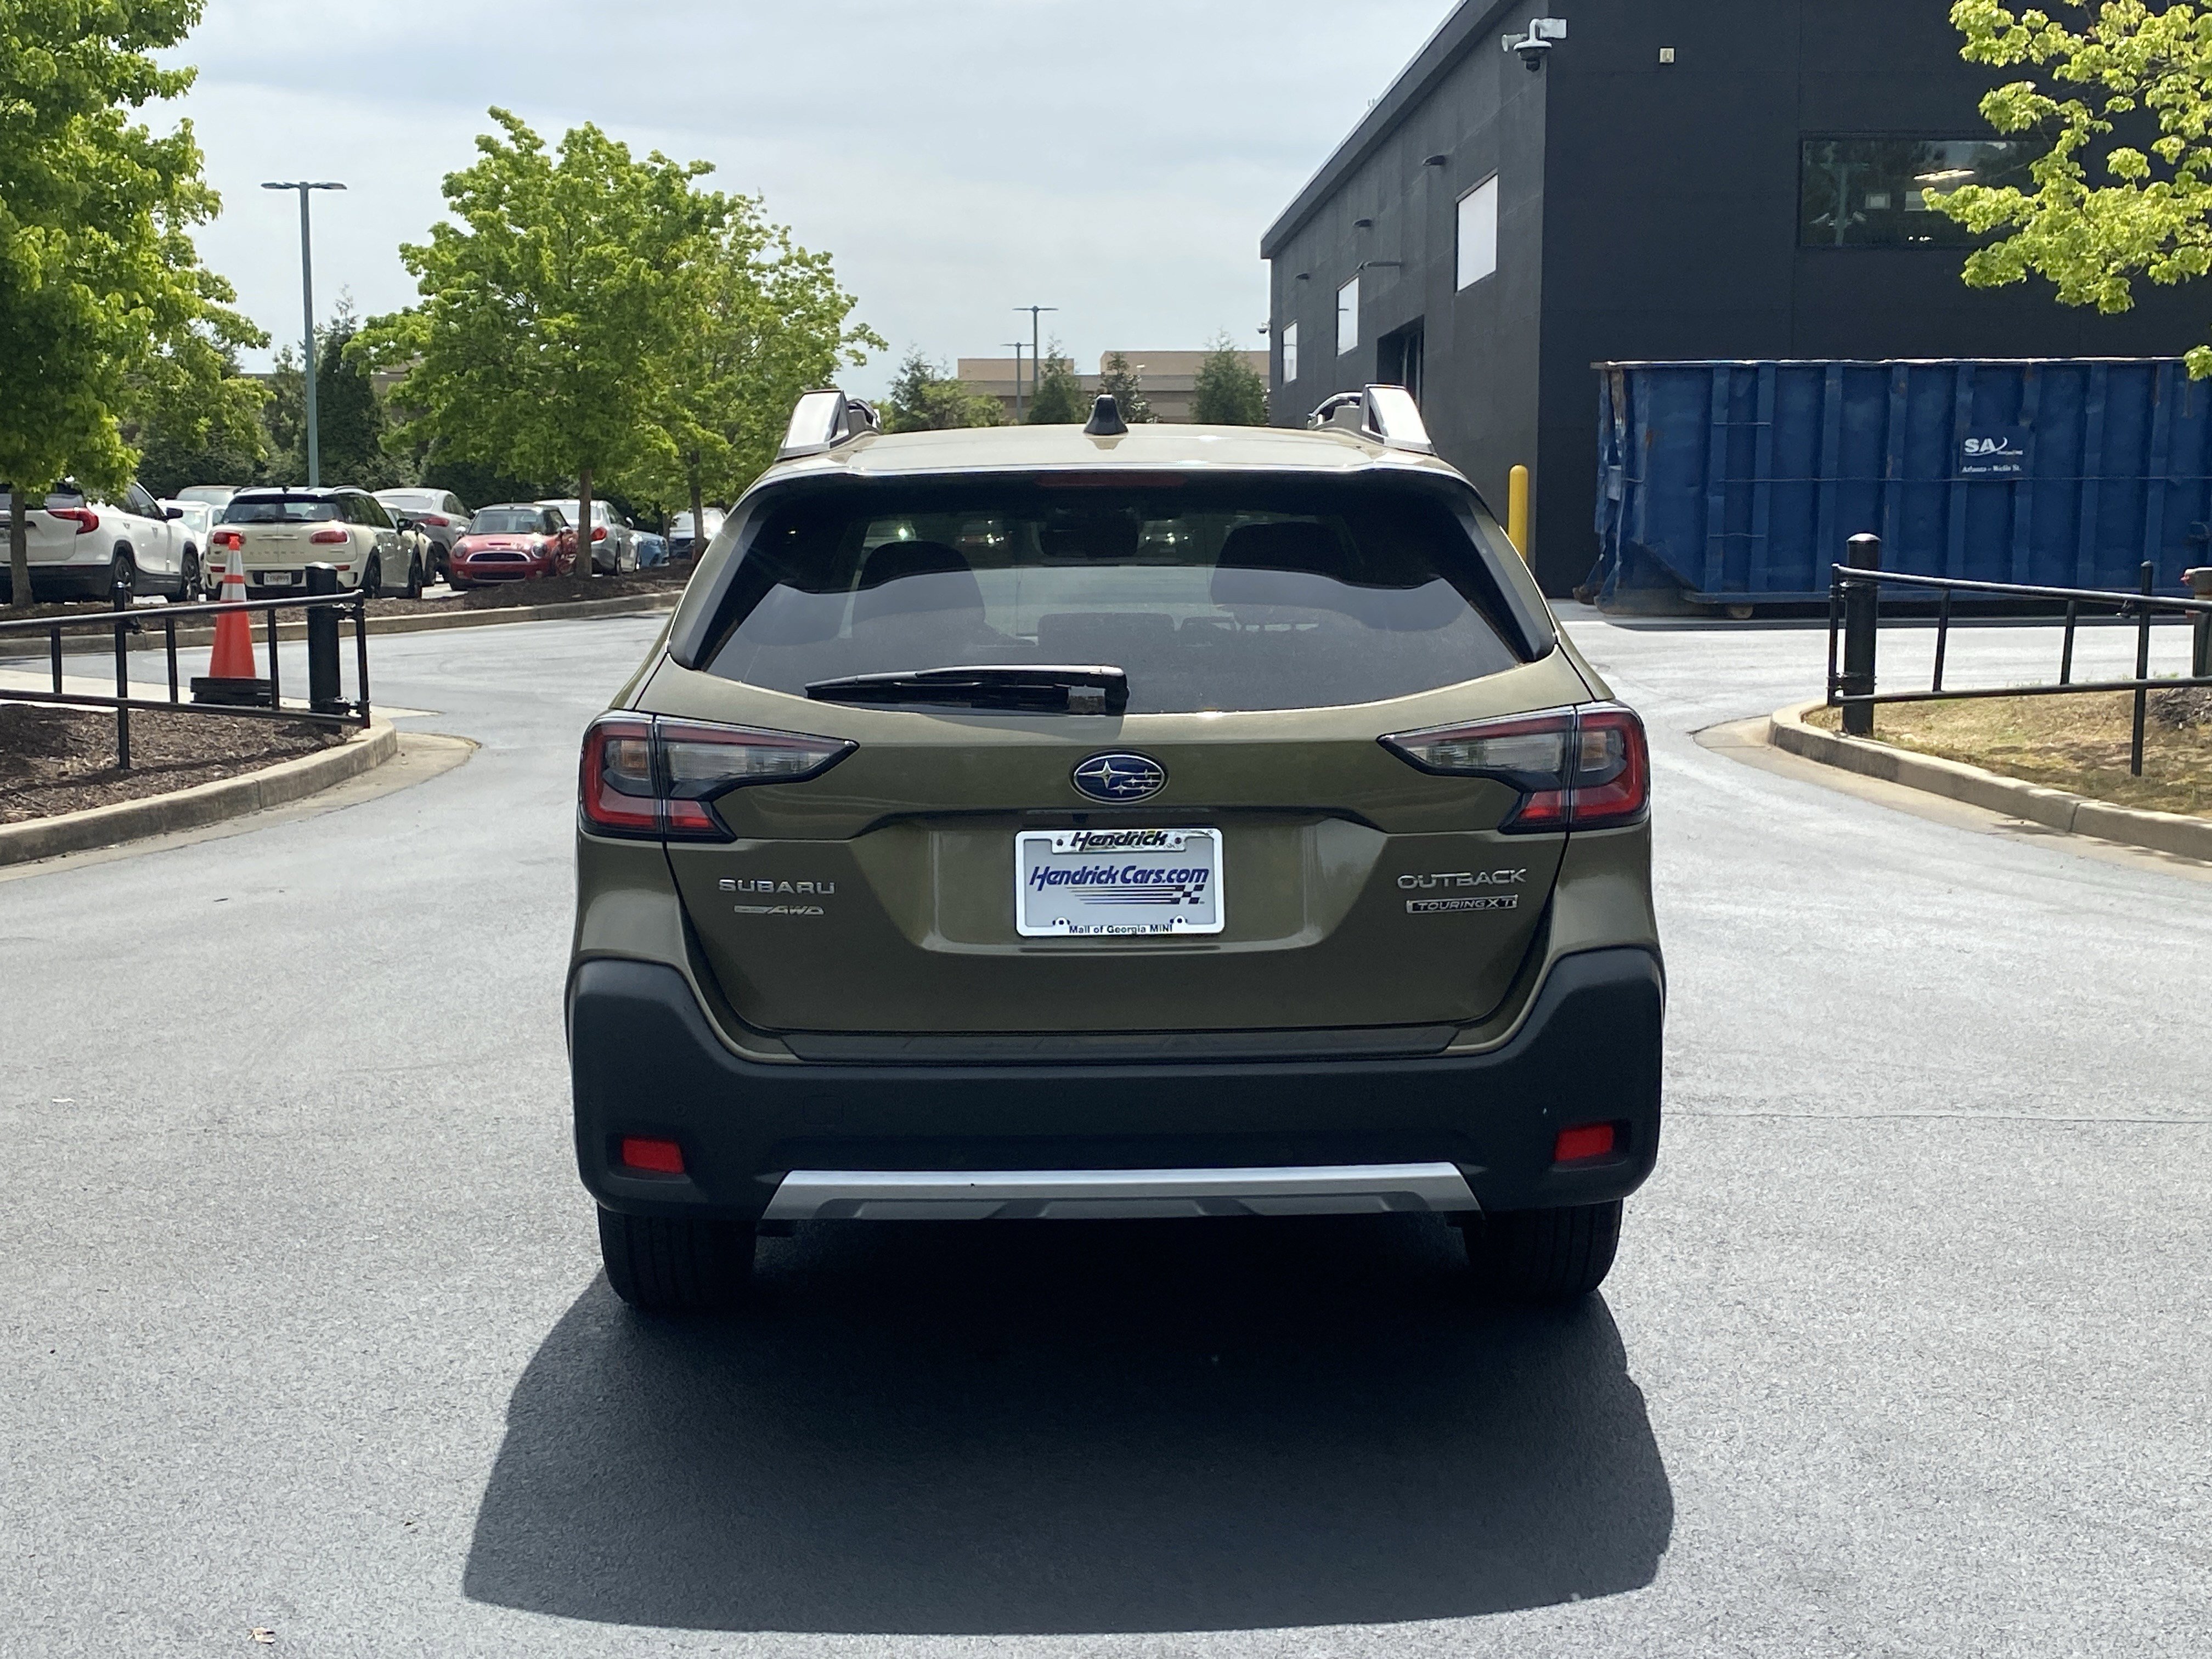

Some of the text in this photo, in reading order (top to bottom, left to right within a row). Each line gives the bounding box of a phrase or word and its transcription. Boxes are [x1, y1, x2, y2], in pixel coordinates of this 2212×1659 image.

[1965, 438, 1996, 453] SA
[1070, 831, 1169, 851] Hendrick
[1397, 868, 1527, 889] OUTBACK
[719, 879, 836, 894] SUBARU
[768, 905, 825, 915] AWD
[1418, 899, 1485, 911] TOURING
[1069, 924, 1173, 935] Mall of Georgia MINI
